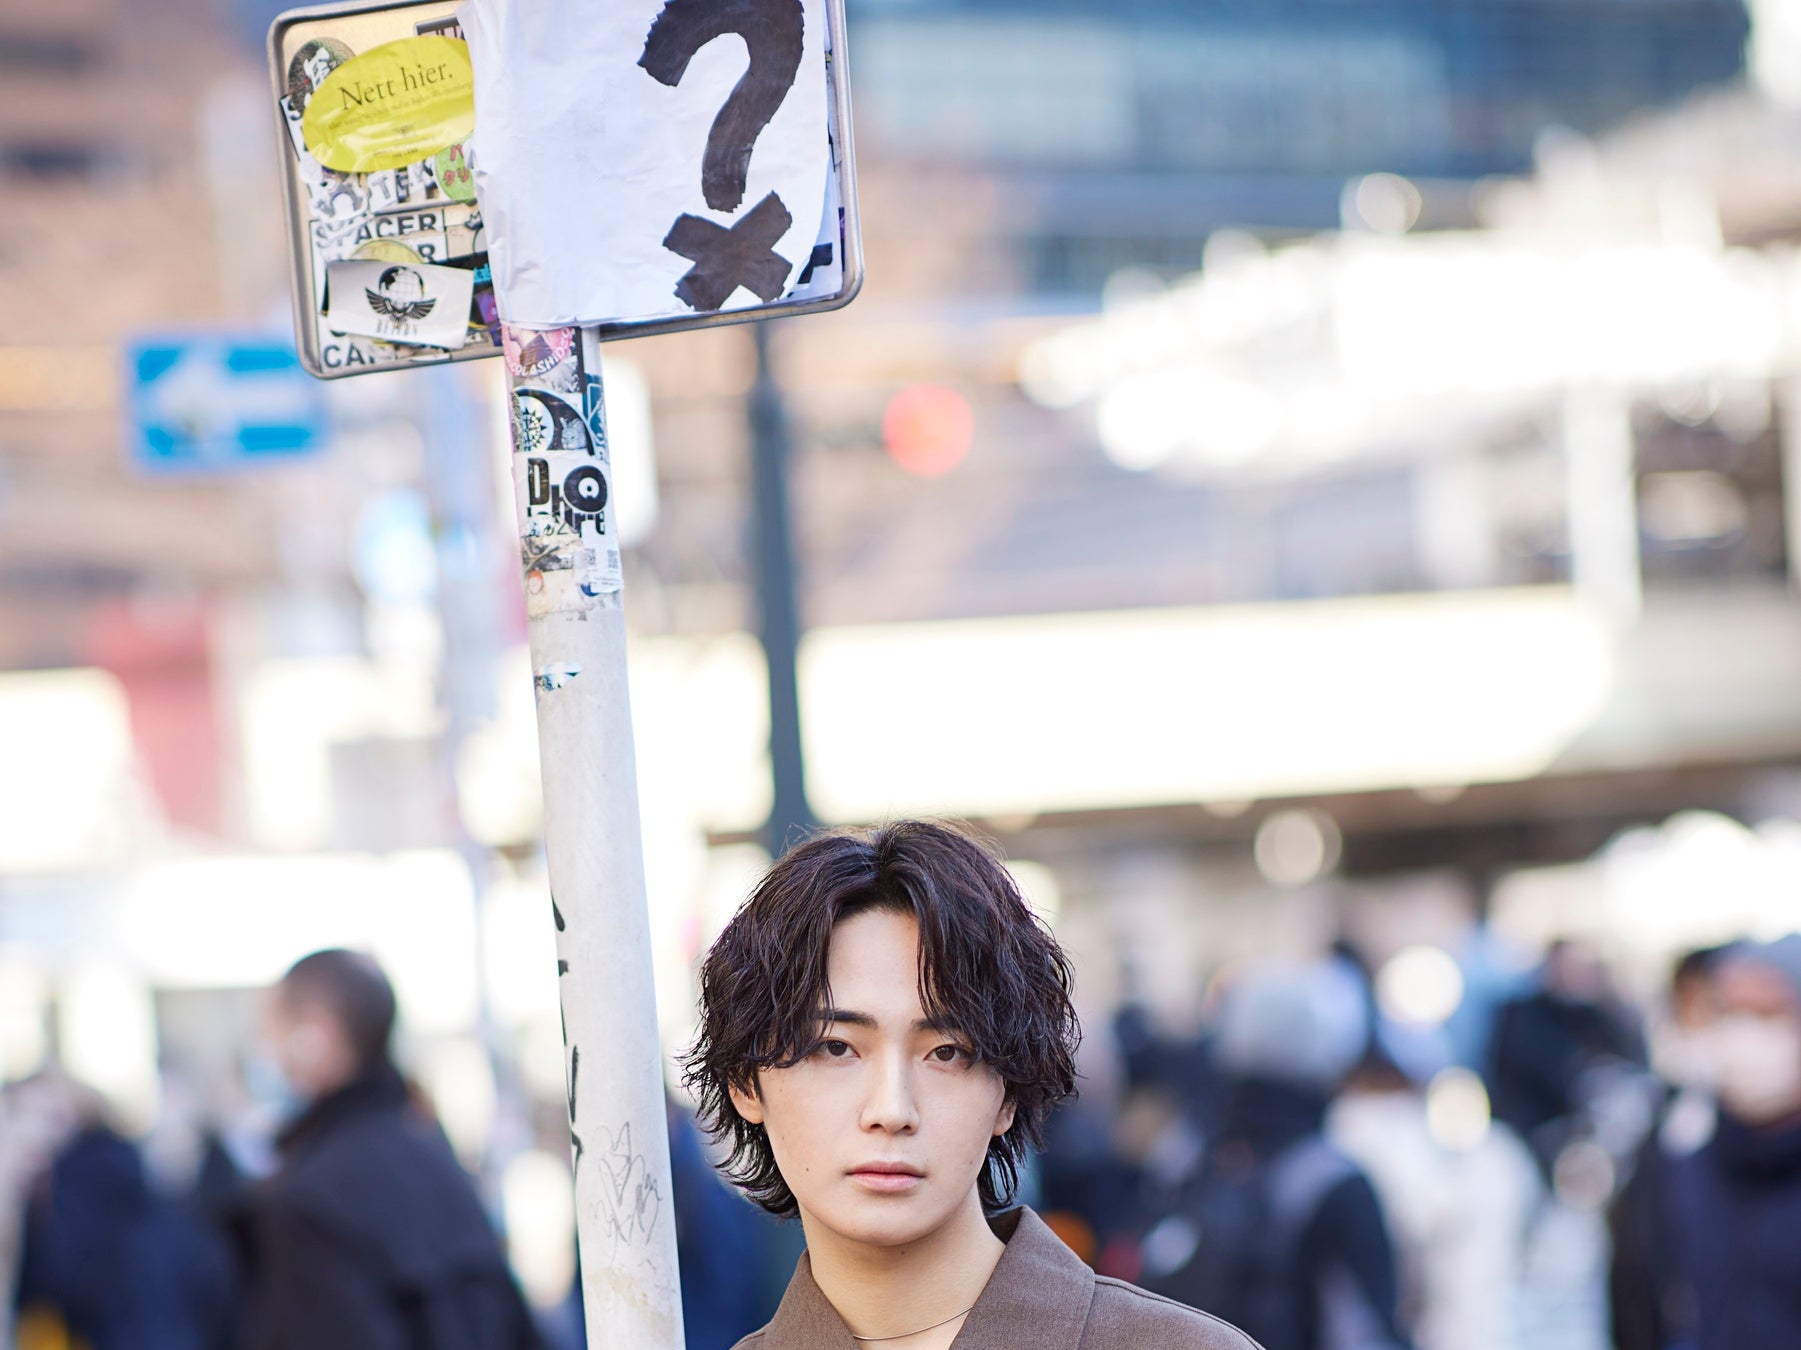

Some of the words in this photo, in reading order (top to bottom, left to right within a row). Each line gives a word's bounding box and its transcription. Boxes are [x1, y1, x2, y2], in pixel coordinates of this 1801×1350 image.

[338, 81, 396, 110] Nett
[400, 63, 454, 92] hier.
[323, 343, 376, 369] CA
